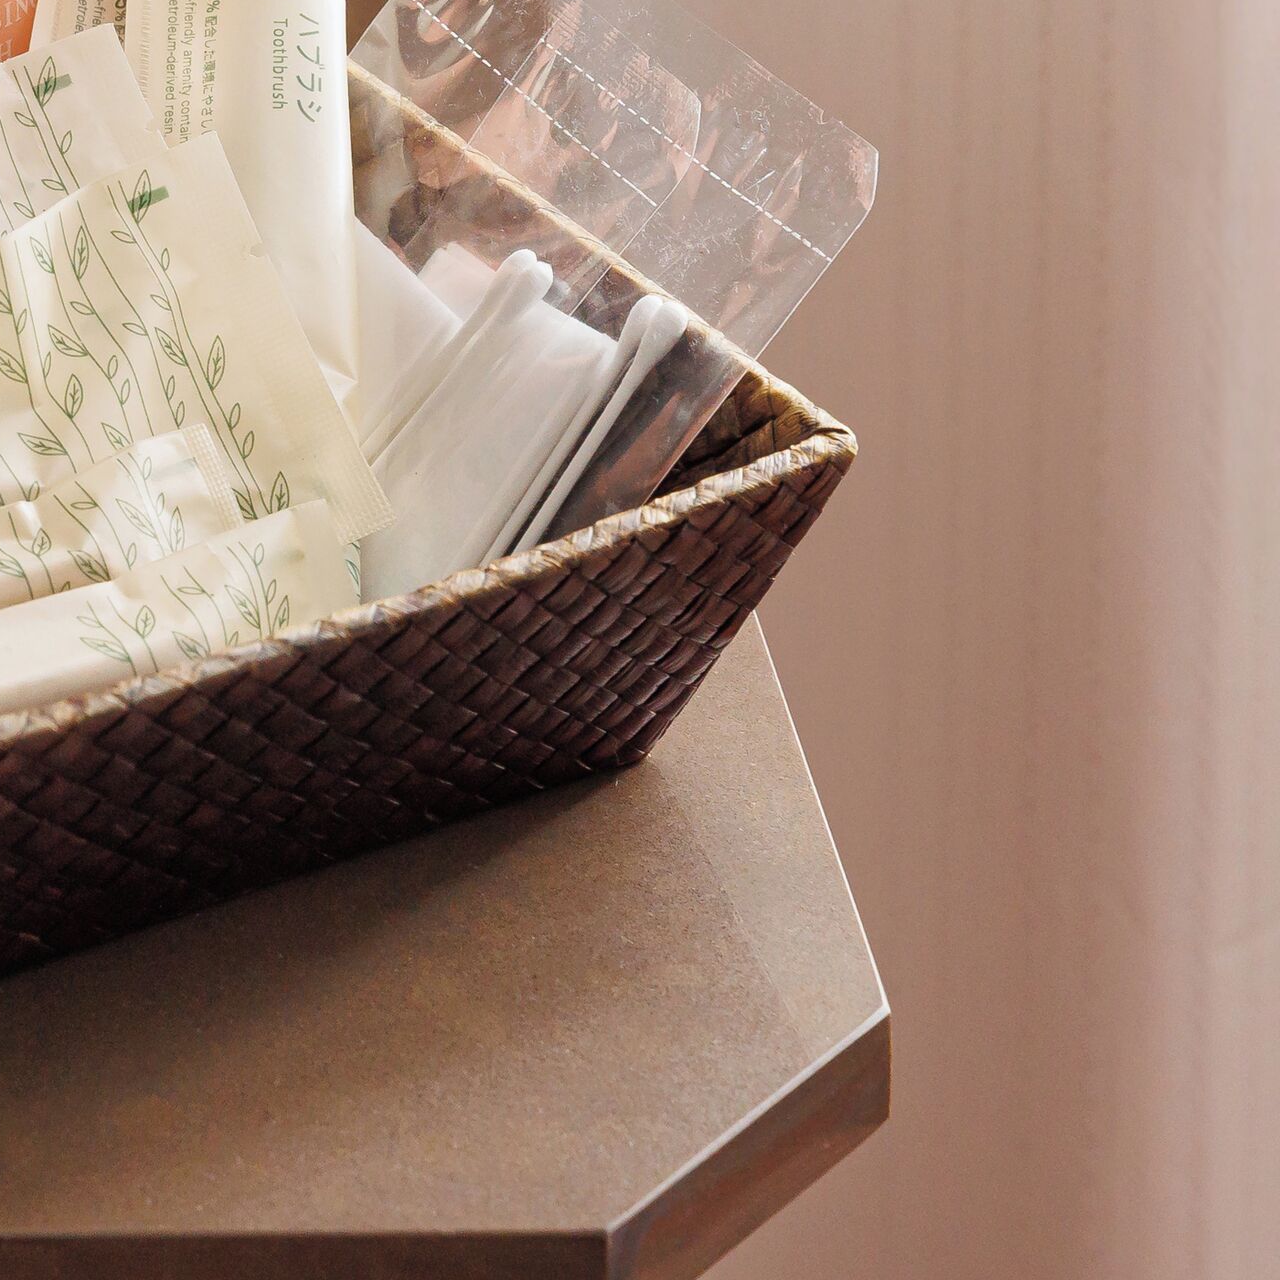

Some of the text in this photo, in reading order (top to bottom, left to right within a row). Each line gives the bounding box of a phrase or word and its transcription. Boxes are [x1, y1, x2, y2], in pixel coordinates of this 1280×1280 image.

[179, 49, 194, 96] amenity
[272, 18, 288, 110] Toothbrush
[296, 12, 326, 122] ハブラシ
